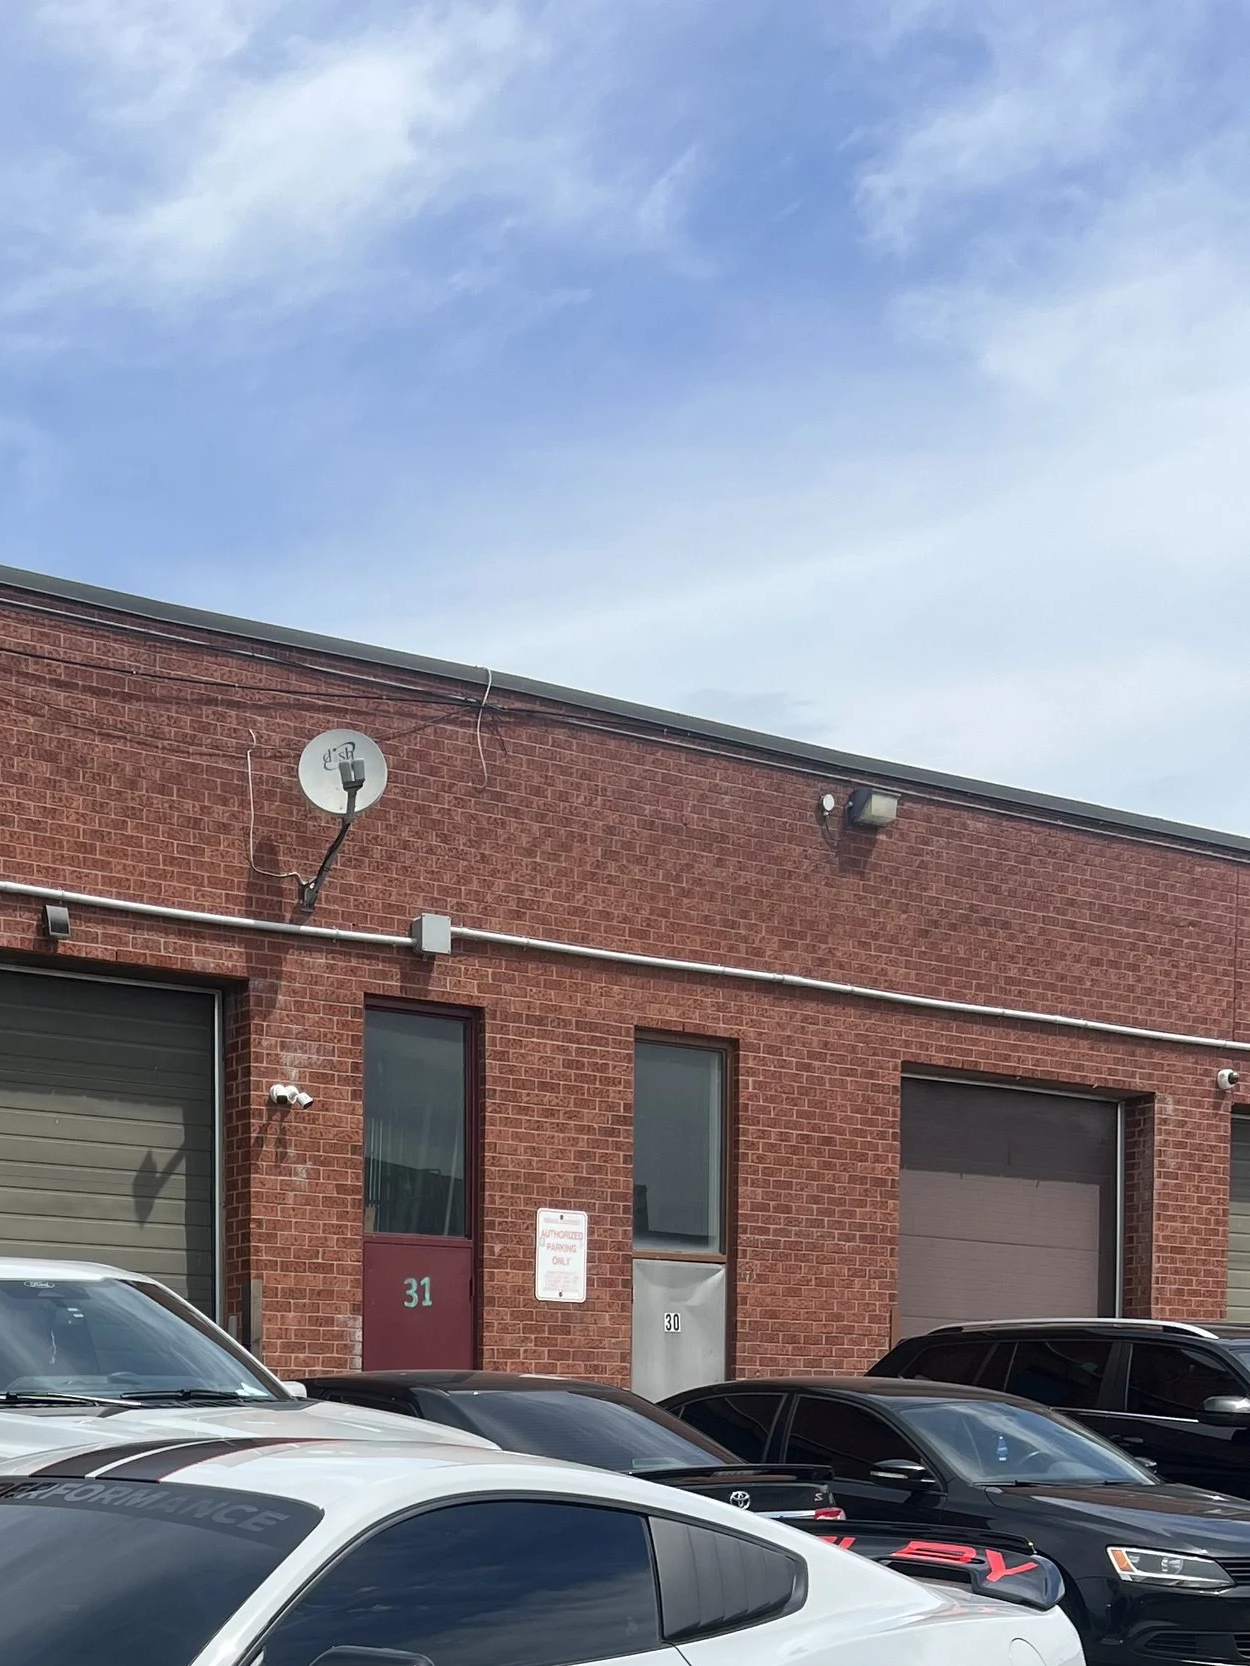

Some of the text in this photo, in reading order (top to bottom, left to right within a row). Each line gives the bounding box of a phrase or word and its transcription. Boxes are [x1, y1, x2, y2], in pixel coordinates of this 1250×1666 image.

[541, 1229, 583, 1241] AUTHORIZED
[546, 1243, 577, 1253] PARKING
[552, 1256, 571, 1266] ONLY
[403, 1276, 433, 1308] 31
[665, 1313, 680, 1331] 30
